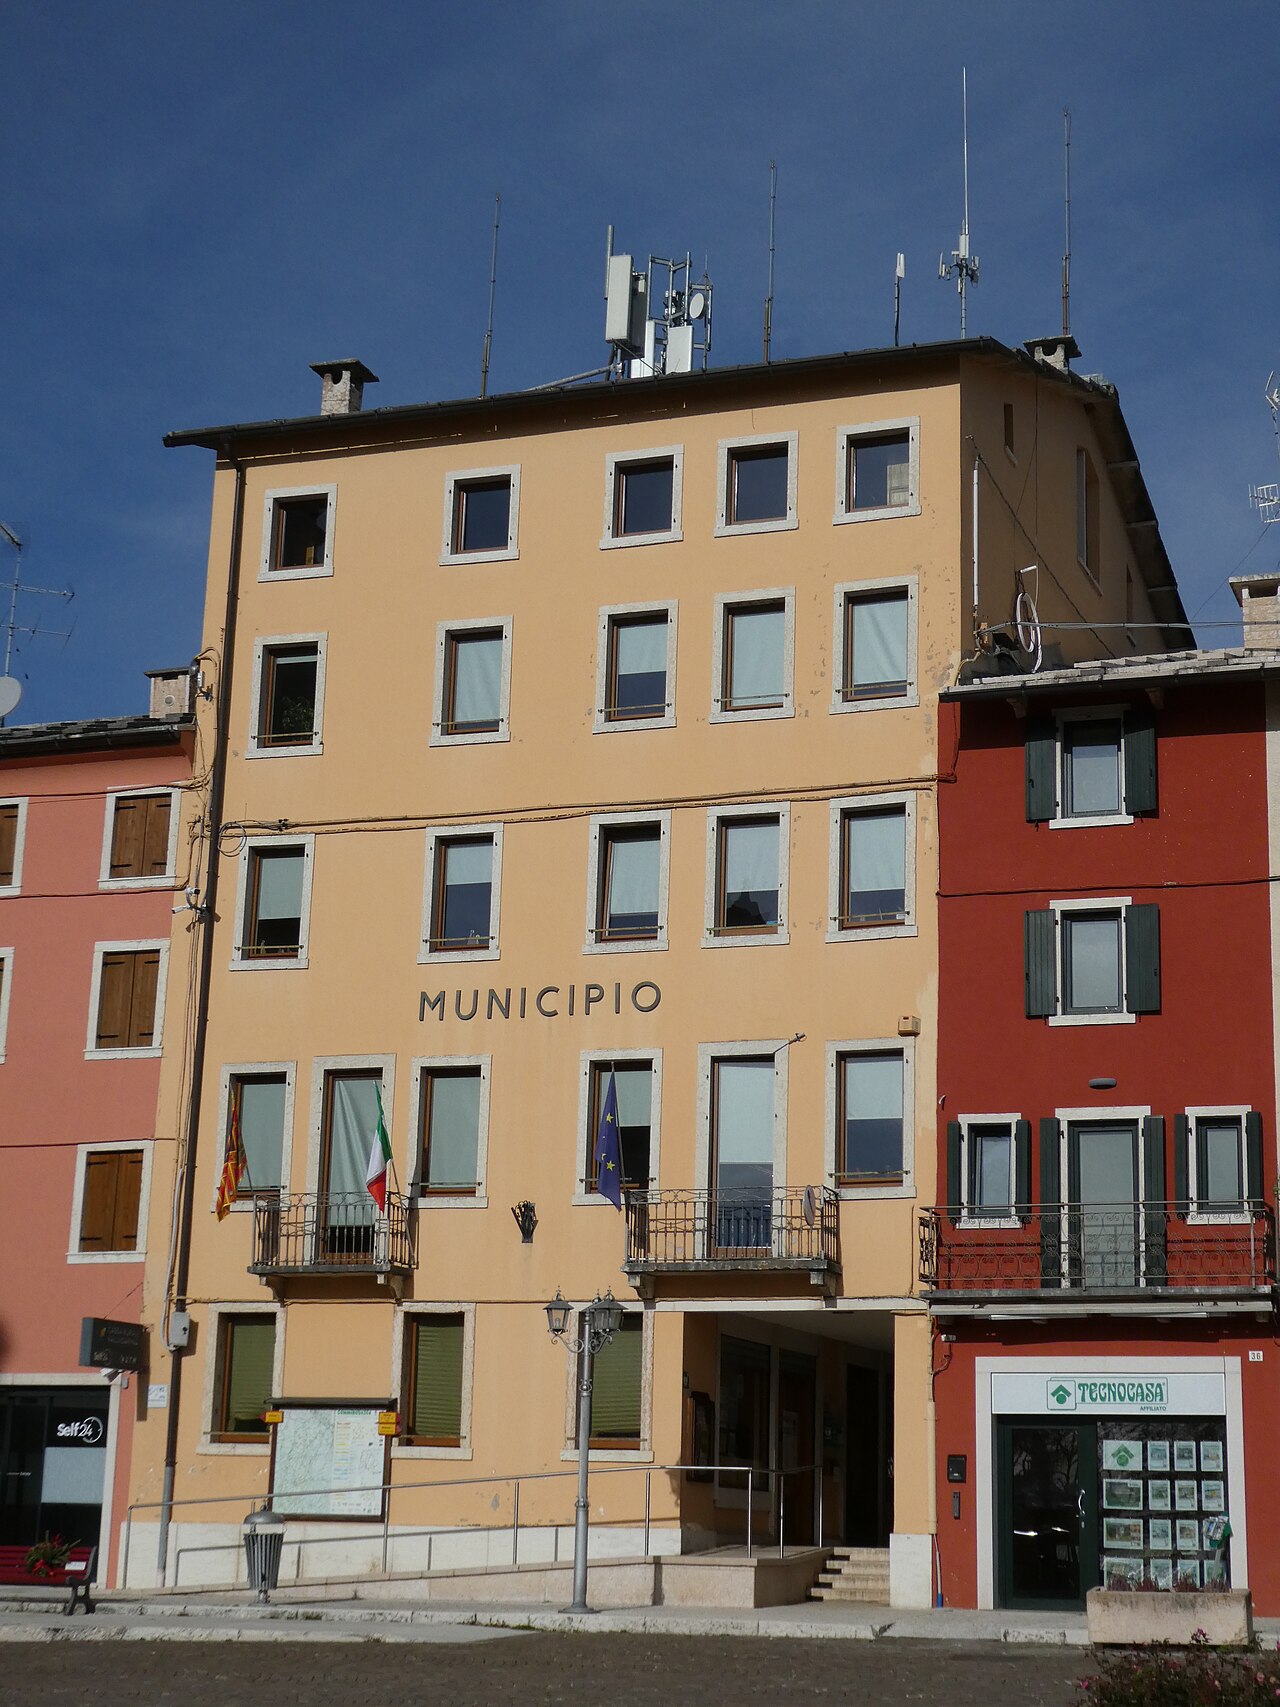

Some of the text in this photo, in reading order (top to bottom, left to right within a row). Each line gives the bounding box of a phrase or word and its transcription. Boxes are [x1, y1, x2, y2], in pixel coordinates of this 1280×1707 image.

[418, 980, 662, 1022] MUNICIPIO
[1251, 1352, 1262, 1360] 36
[1078, 1382, 1164, 1402] TECNOCASA
